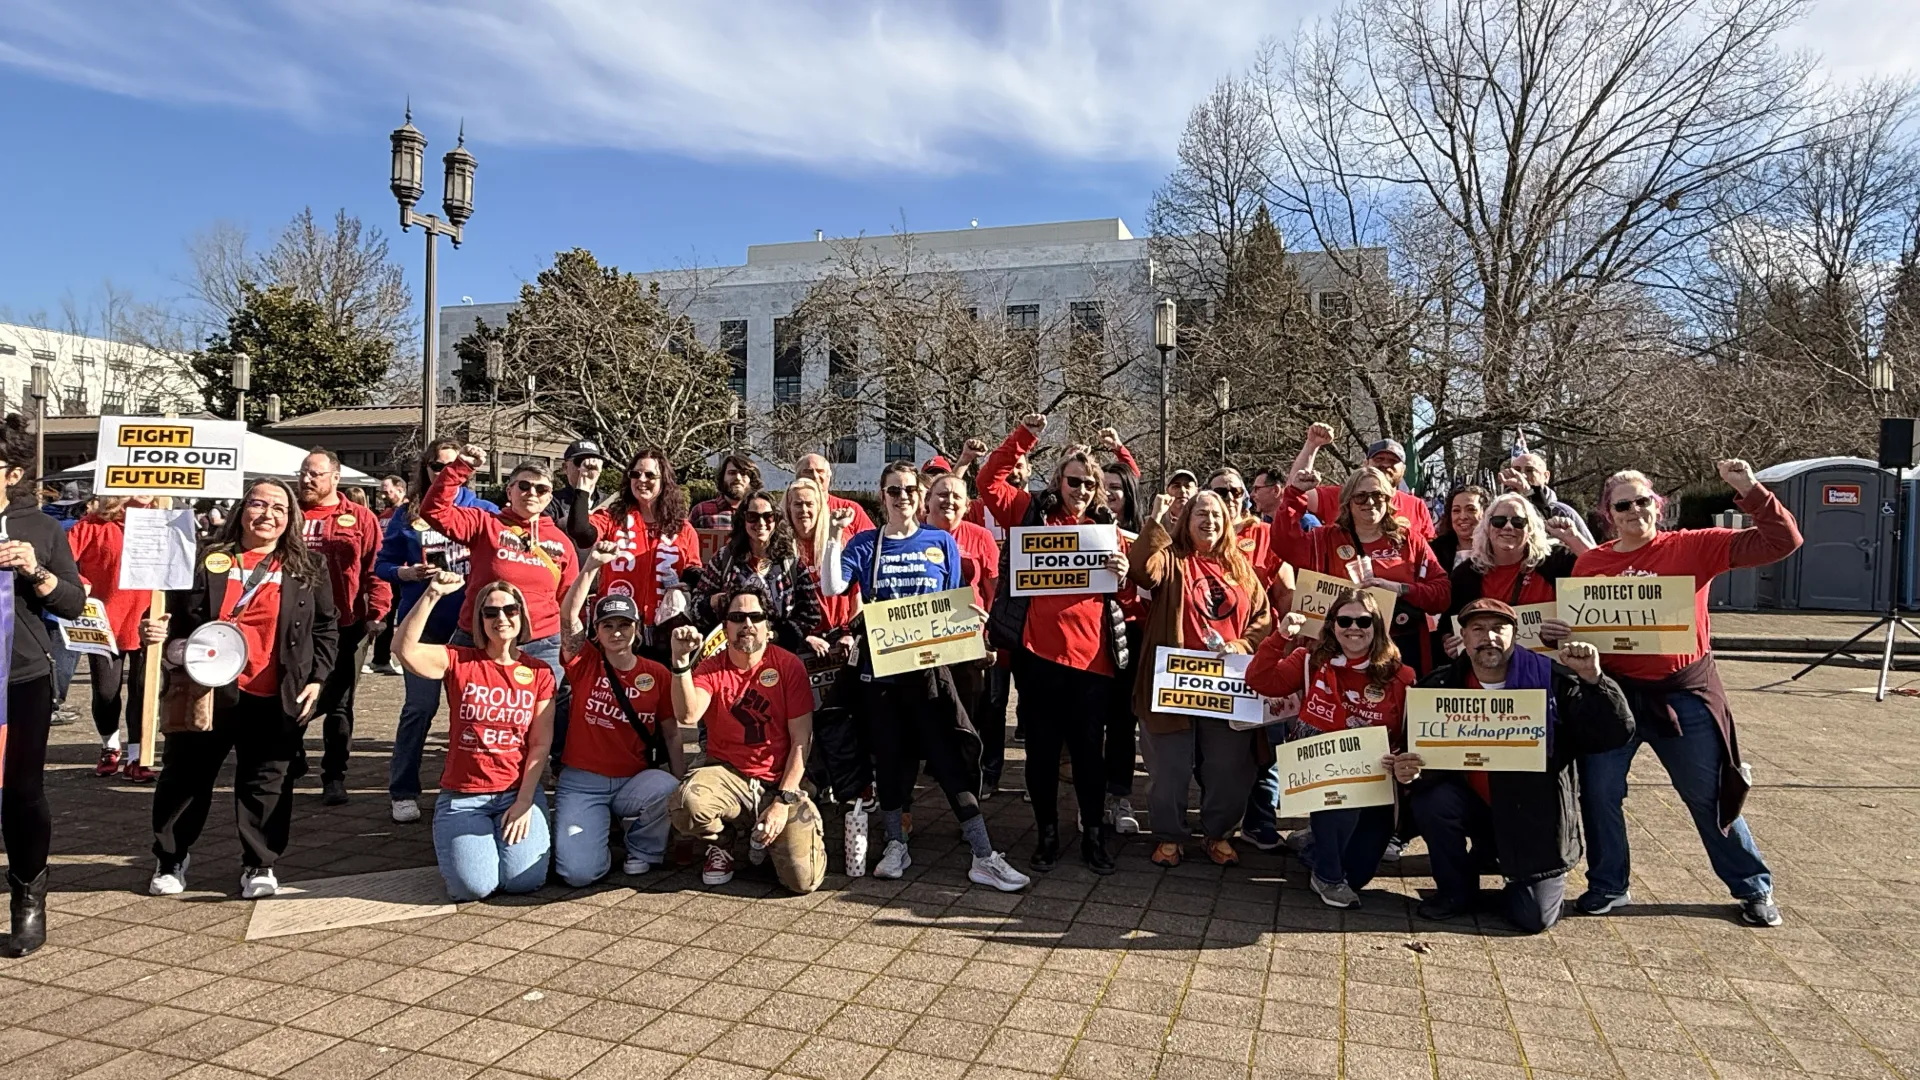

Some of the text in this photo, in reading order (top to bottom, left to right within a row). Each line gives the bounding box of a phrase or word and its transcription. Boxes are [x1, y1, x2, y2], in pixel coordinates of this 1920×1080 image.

[122, 429, 189, 443] FIGHT
[133, 450, 232, 465] FOR OUR
[111, 471, 200, 485] FUTURE
[1024, 536, 1076, 549] FIGHT
[880, 553, 900, 565] Save
[901, 551, 928, 562] Publi
[1035, 554, 1109, 568] FOR OUR
[1019, 572, 1087, 587] FUTURE
[1584, 584, 1662, 601] PROTECT OUR
[887, 597, 952, 622] PROTECT OUR
[1521, 610, 1543, 626] OUR
[1568, 603, 1657, 627] YOUTH
[871, 627, 924, 648] Public
[1170, 658, 1221, 674] FIGHT
[1178, 676, 1254, 696] FOR OUR
[462, 682, 535, 709] PROUD
[591, 689, 613, 702] with
[1161, 692, 1231, 710] FUTURE
[1436, 697, 1515, 714] PROTECT OUR
[460, 703, 532, 726] EDUCATOR
[1498, 713, 1532, 722] from
[1417, 722, 1546, 741] ICE Kidnappings
[1297, 736, 1362, 762] PROTECT OUR
[1288, 761, 1372, 790] Public Schools
